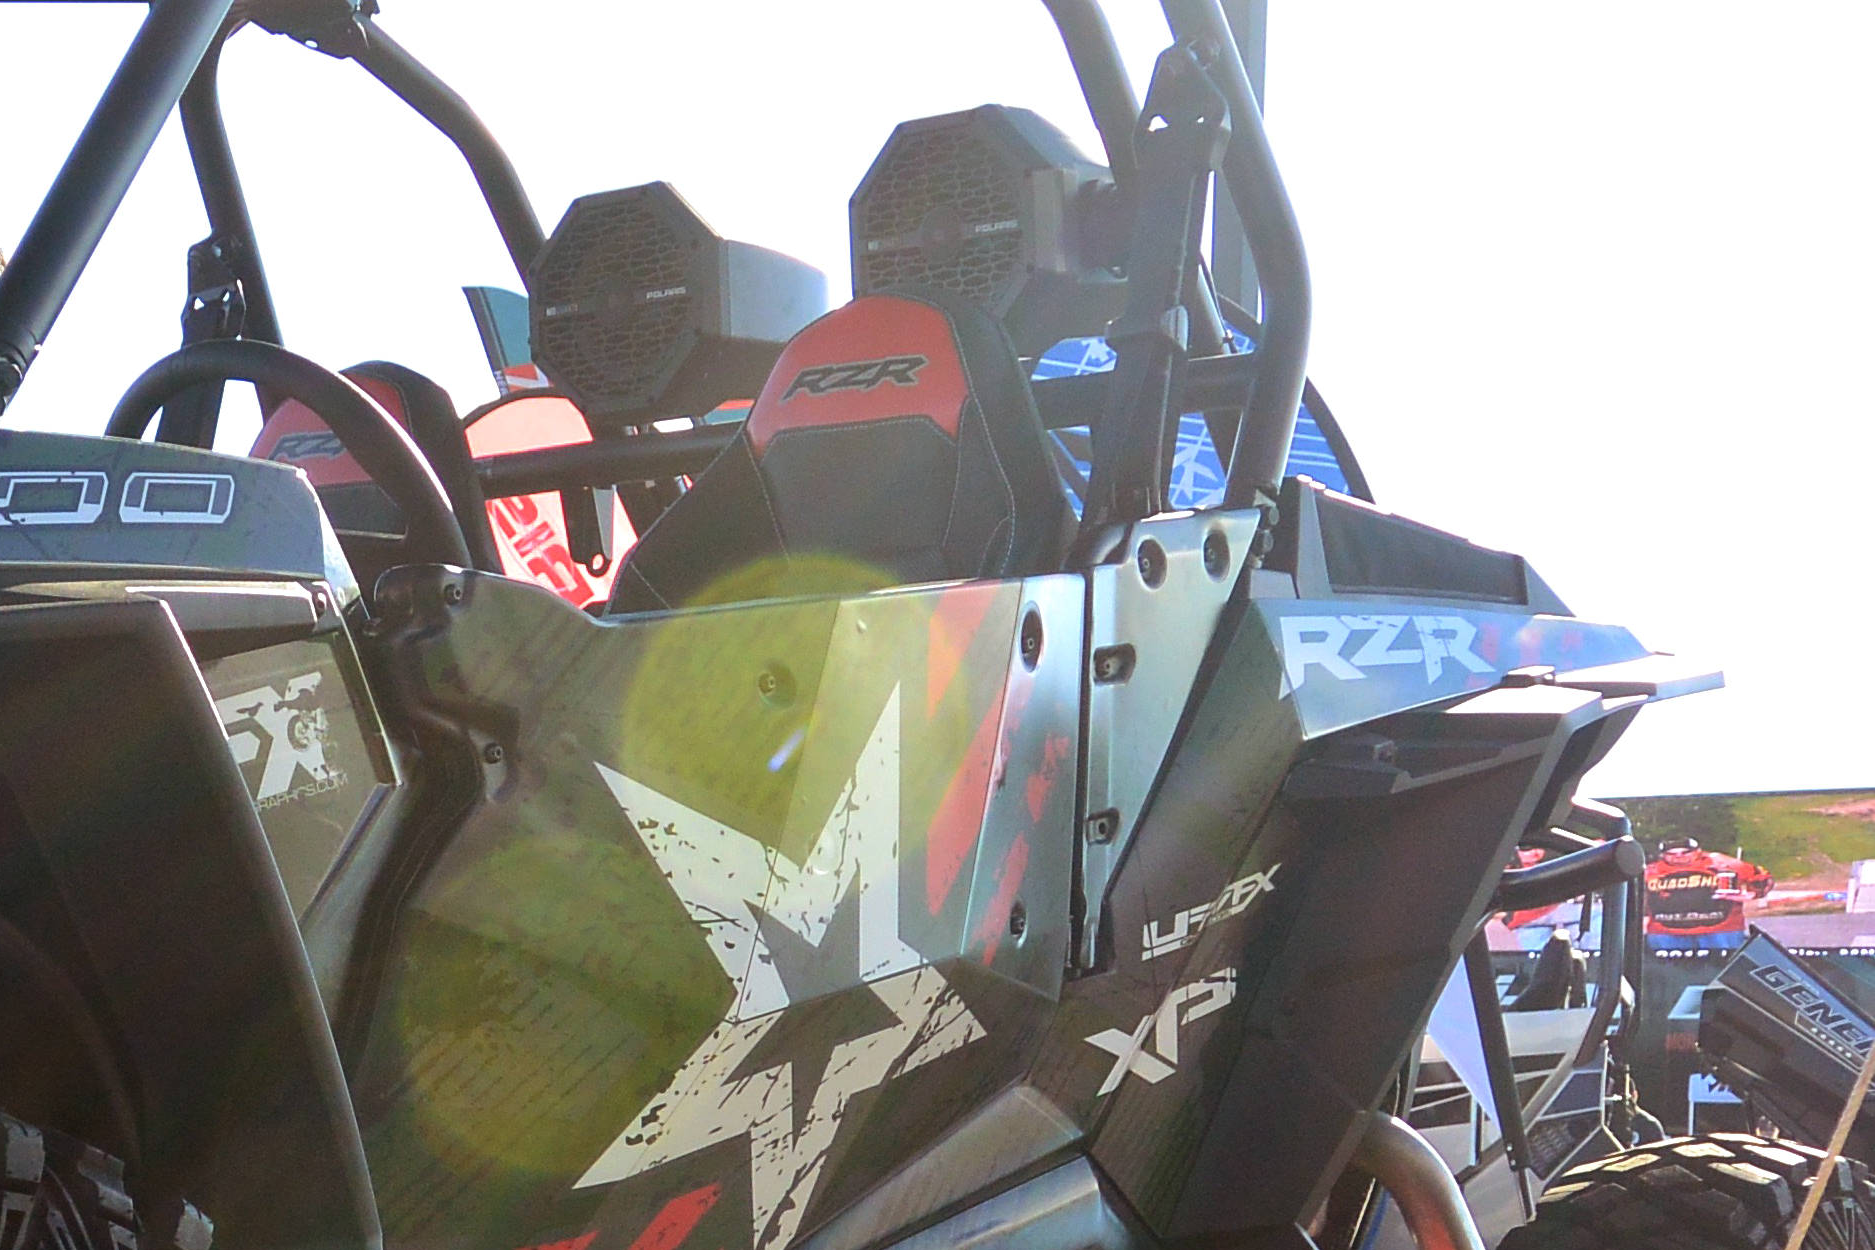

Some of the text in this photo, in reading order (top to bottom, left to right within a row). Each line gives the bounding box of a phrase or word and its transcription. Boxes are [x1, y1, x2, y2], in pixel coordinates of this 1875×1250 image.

[975, 219, 1018, 232] POLARIS
[646, 286, 686, 300] POLARIS
[779, 353, 928, 405] RZR
[267, 430, 348, 461] RZ
[1278, 615, 1497, 700] RZR
[1083, 967, 1237, 1097] XP
